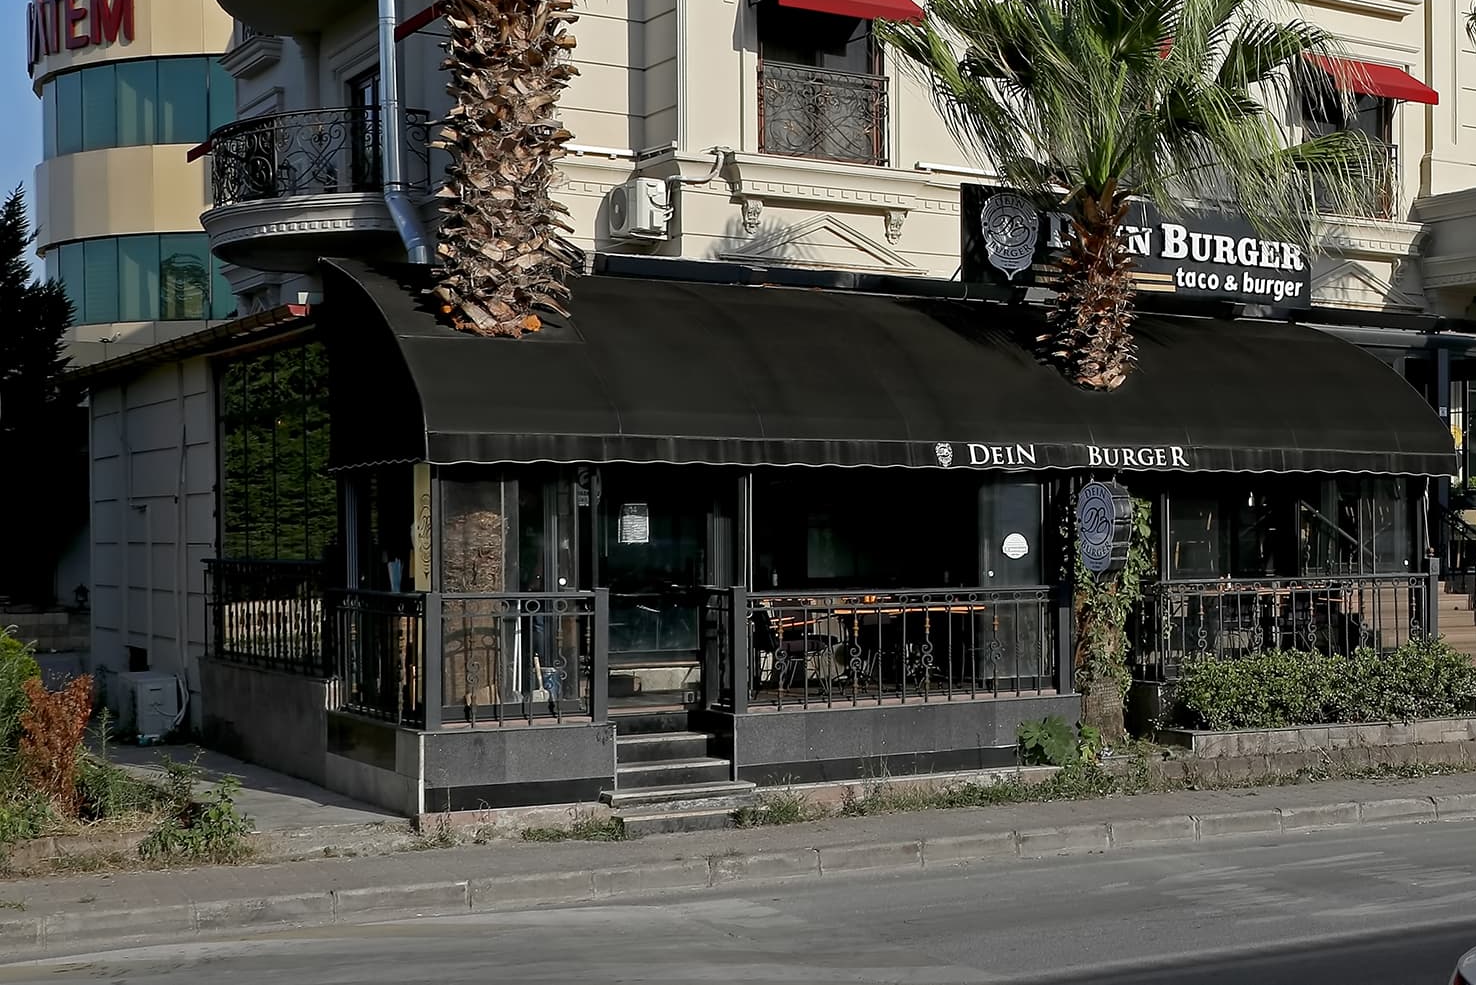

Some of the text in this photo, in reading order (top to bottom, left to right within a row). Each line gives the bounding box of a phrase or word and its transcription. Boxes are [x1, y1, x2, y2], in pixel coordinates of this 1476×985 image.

[1176, 267, 1303, 301] taco & burger
